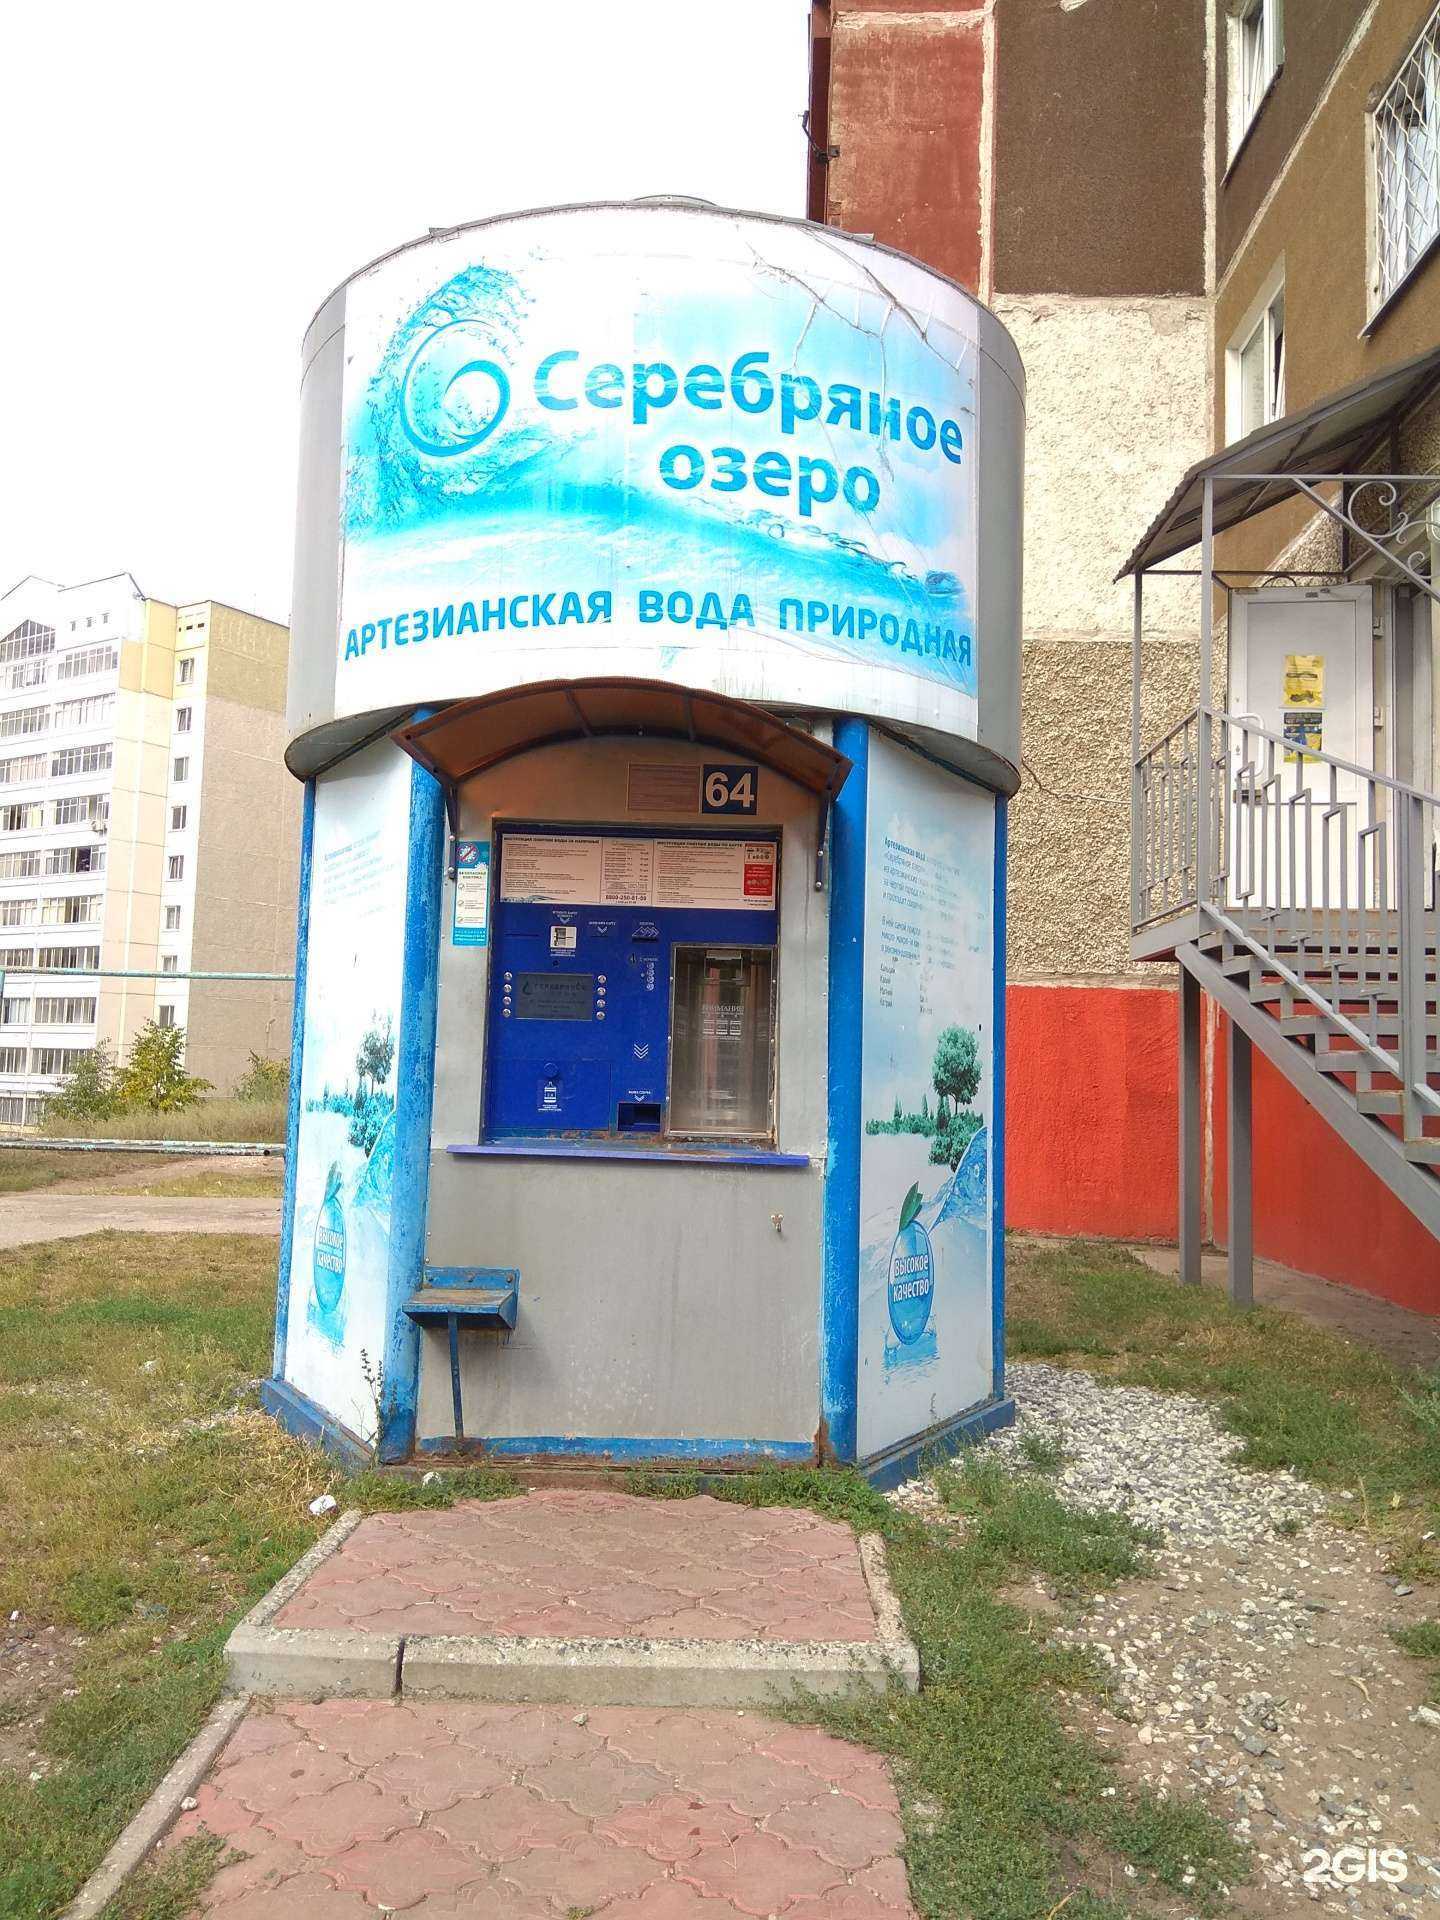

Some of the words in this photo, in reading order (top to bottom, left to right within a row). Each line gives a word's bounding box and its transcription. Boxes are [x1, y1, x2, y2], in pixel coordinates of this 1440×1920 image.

[533, 350, 963, 465] Серебряное
[659, 444, 880, 517] озеро
[344, 590, 612, 661] АРТЕЗИАНСКАЯ
[639, 590, 755, 631] ВОДА
[779, 598, 972, 667] ПРИРОДНАЯ
[705, 771, 755, 808] 64
[893, 1278, 930, 1303] качество
[894, 1254, 929, 1277] высокое
